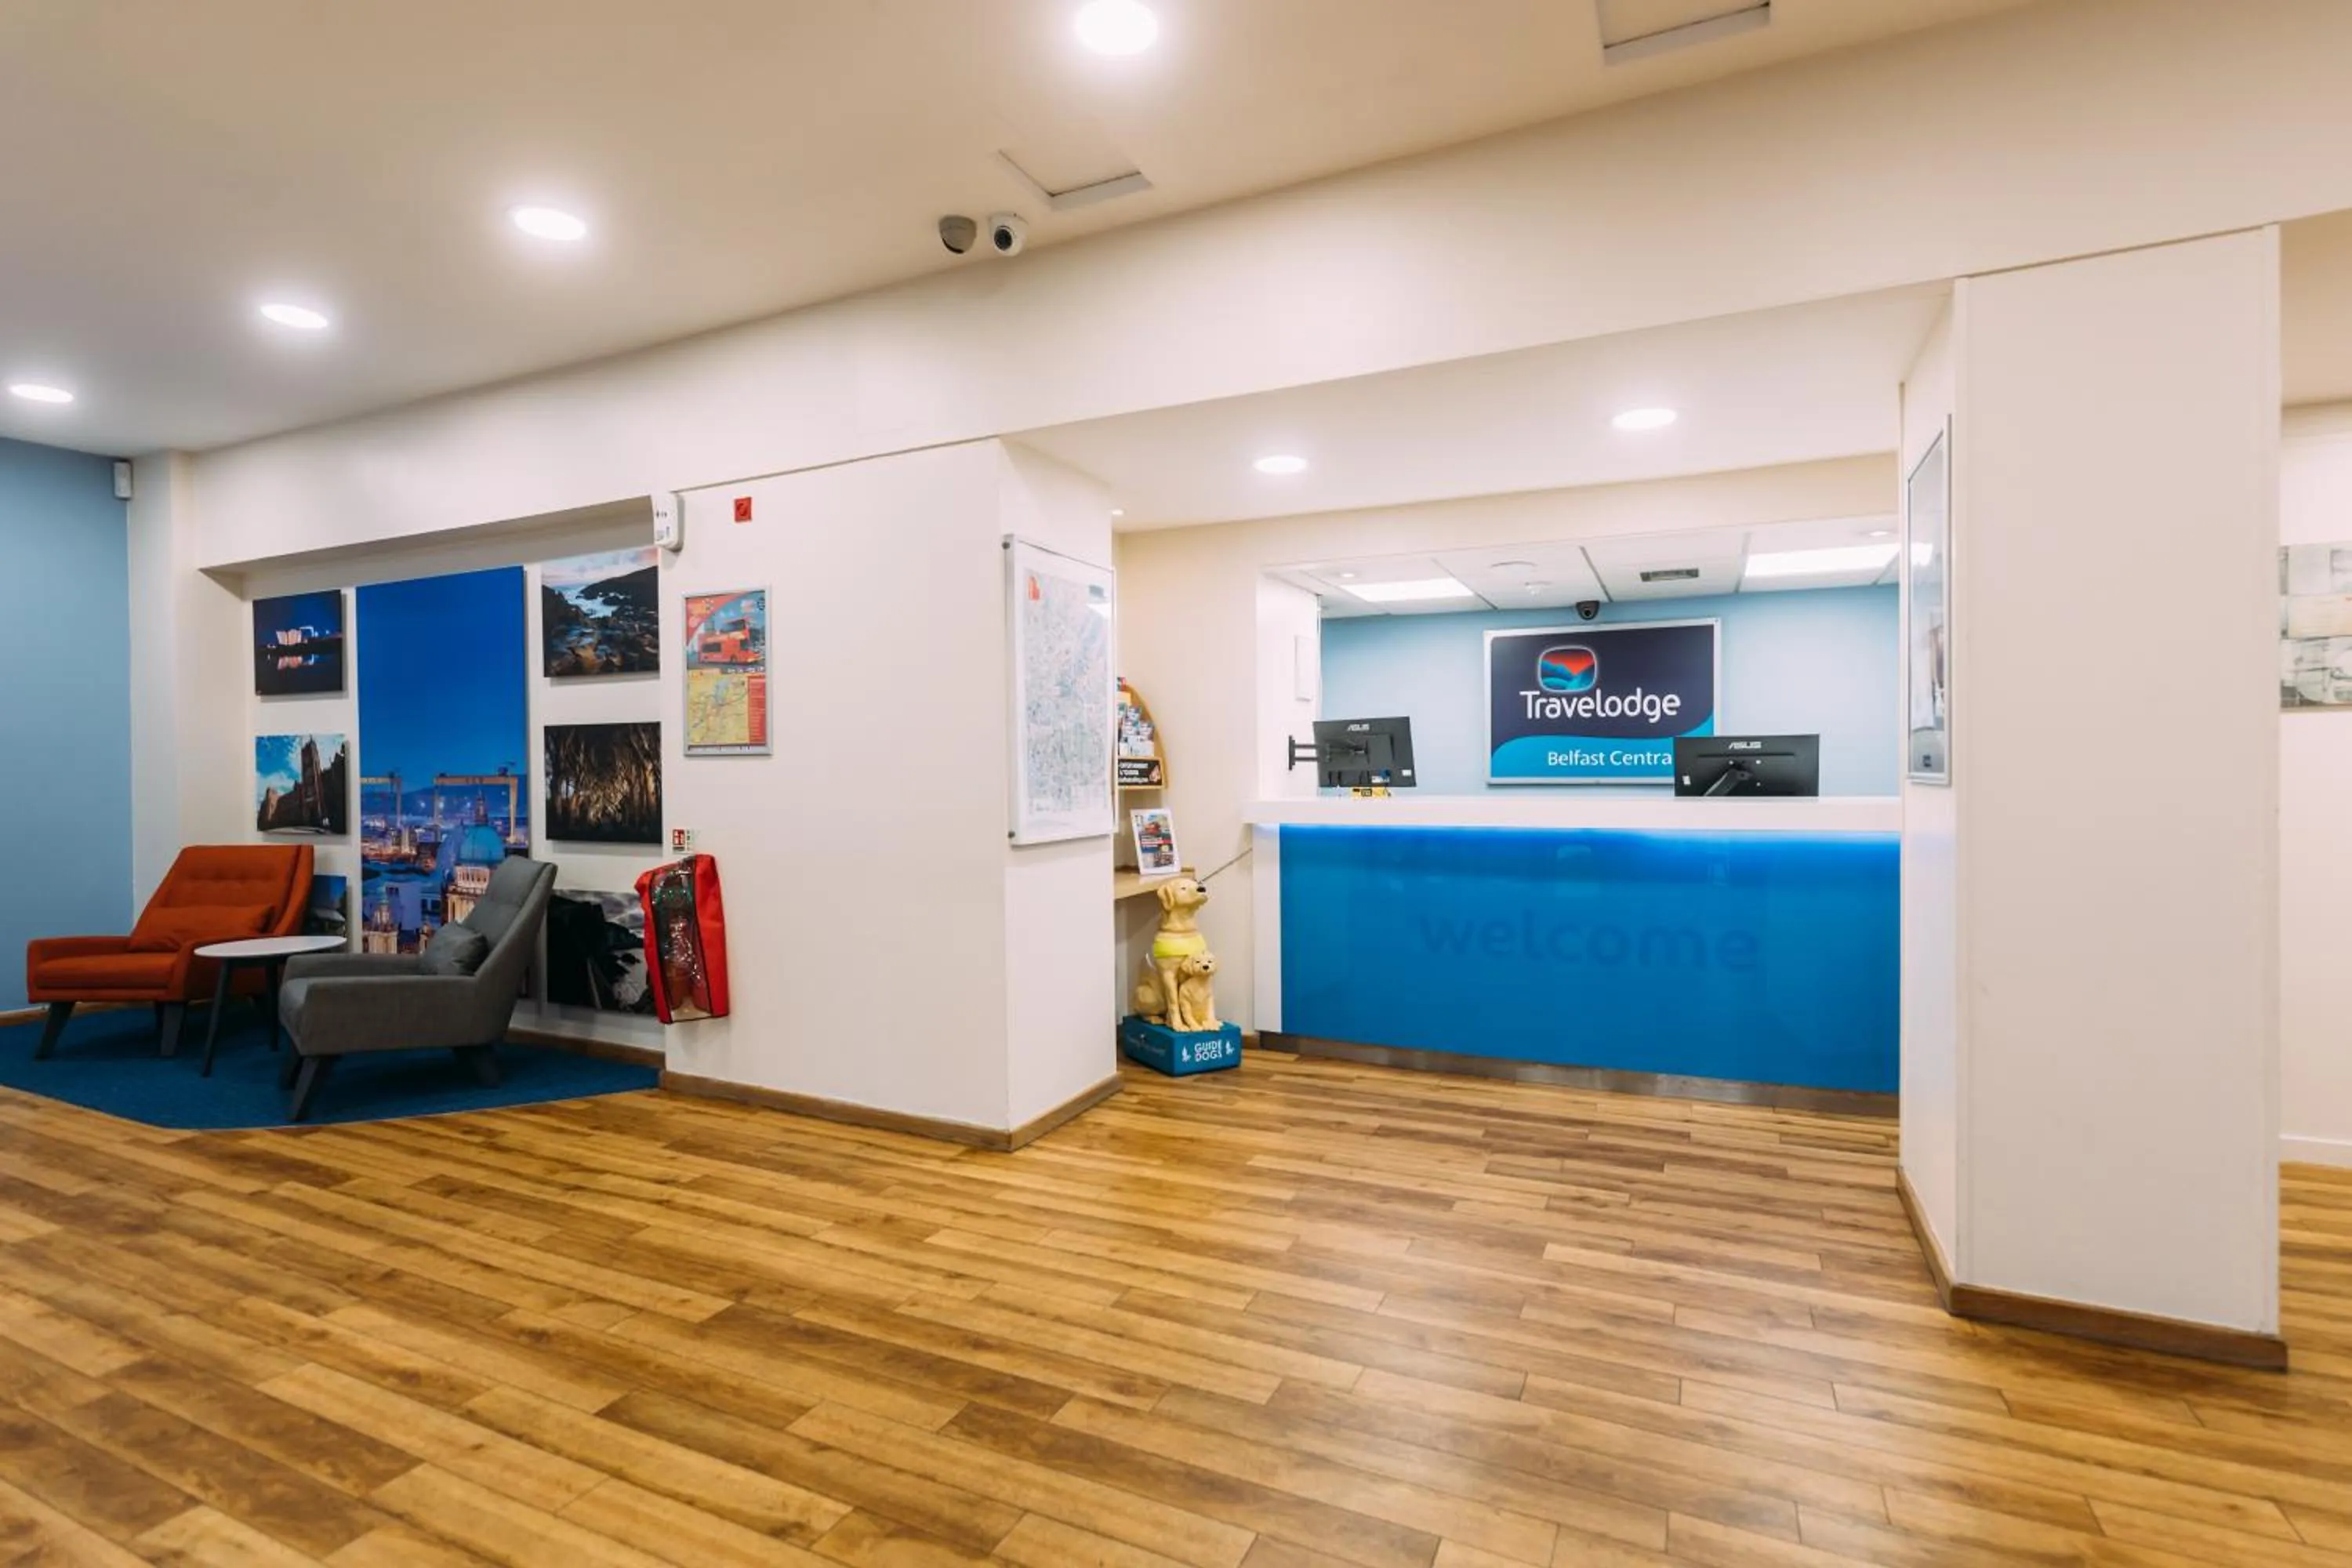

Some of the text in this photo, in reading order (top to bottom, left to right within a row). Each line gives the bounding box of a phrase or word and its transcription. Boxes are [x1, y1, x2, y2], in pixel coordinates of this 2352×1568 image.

[1519, 688, 1681, 723] Travelodge
[1728, 741, 1762, 750] ASUS
[1548, 750, 1672, 766] Belfast Centra
[1418, 909, 1759, 972] welcome
[1194, 1040, 1223, 1054] GUIDE
[1194, 1051, 1223, 1062] DOGS
